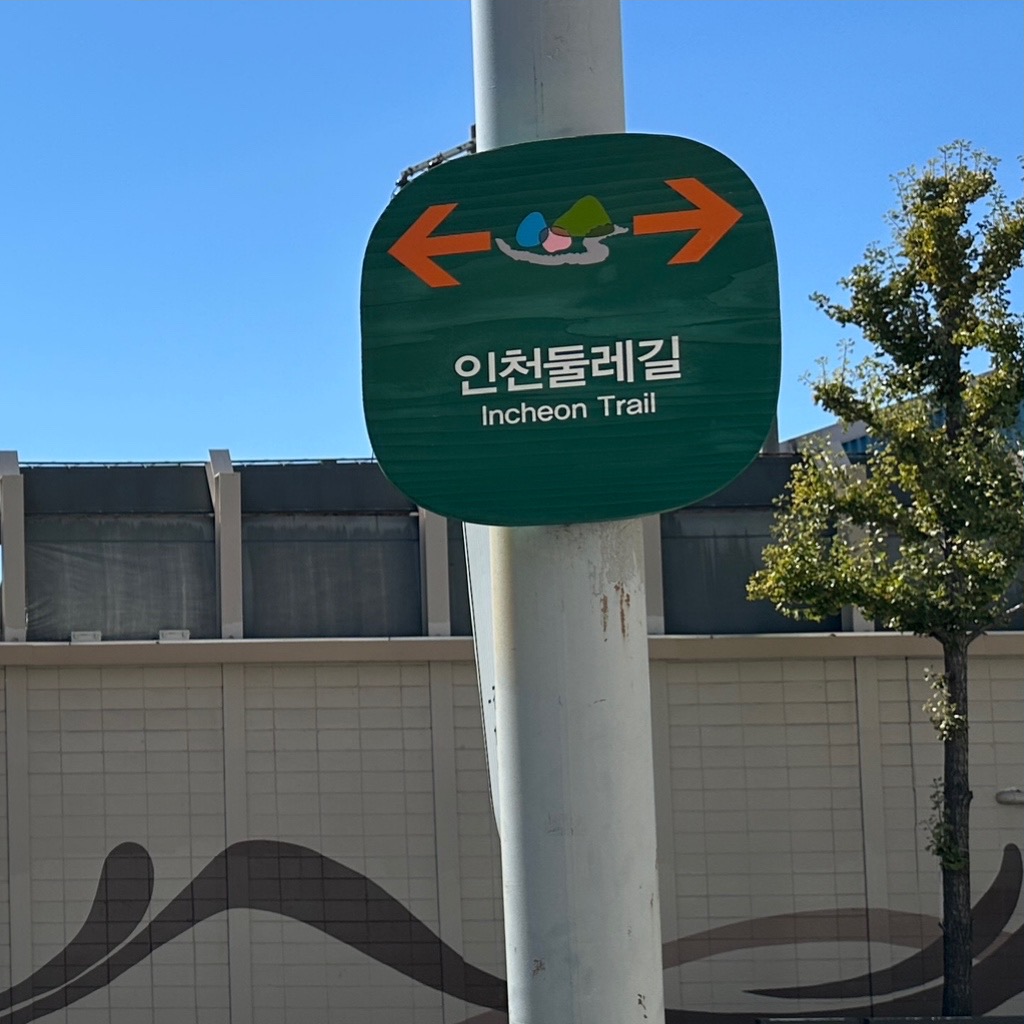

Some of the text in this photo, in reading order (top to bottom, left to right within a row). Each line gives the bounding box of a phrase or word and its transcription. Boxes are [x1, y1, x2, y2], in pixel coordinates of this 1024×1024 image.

[454, 335, 682, 396] 인천둘레길
[481, 392, 656, 426] Incheon Trail
